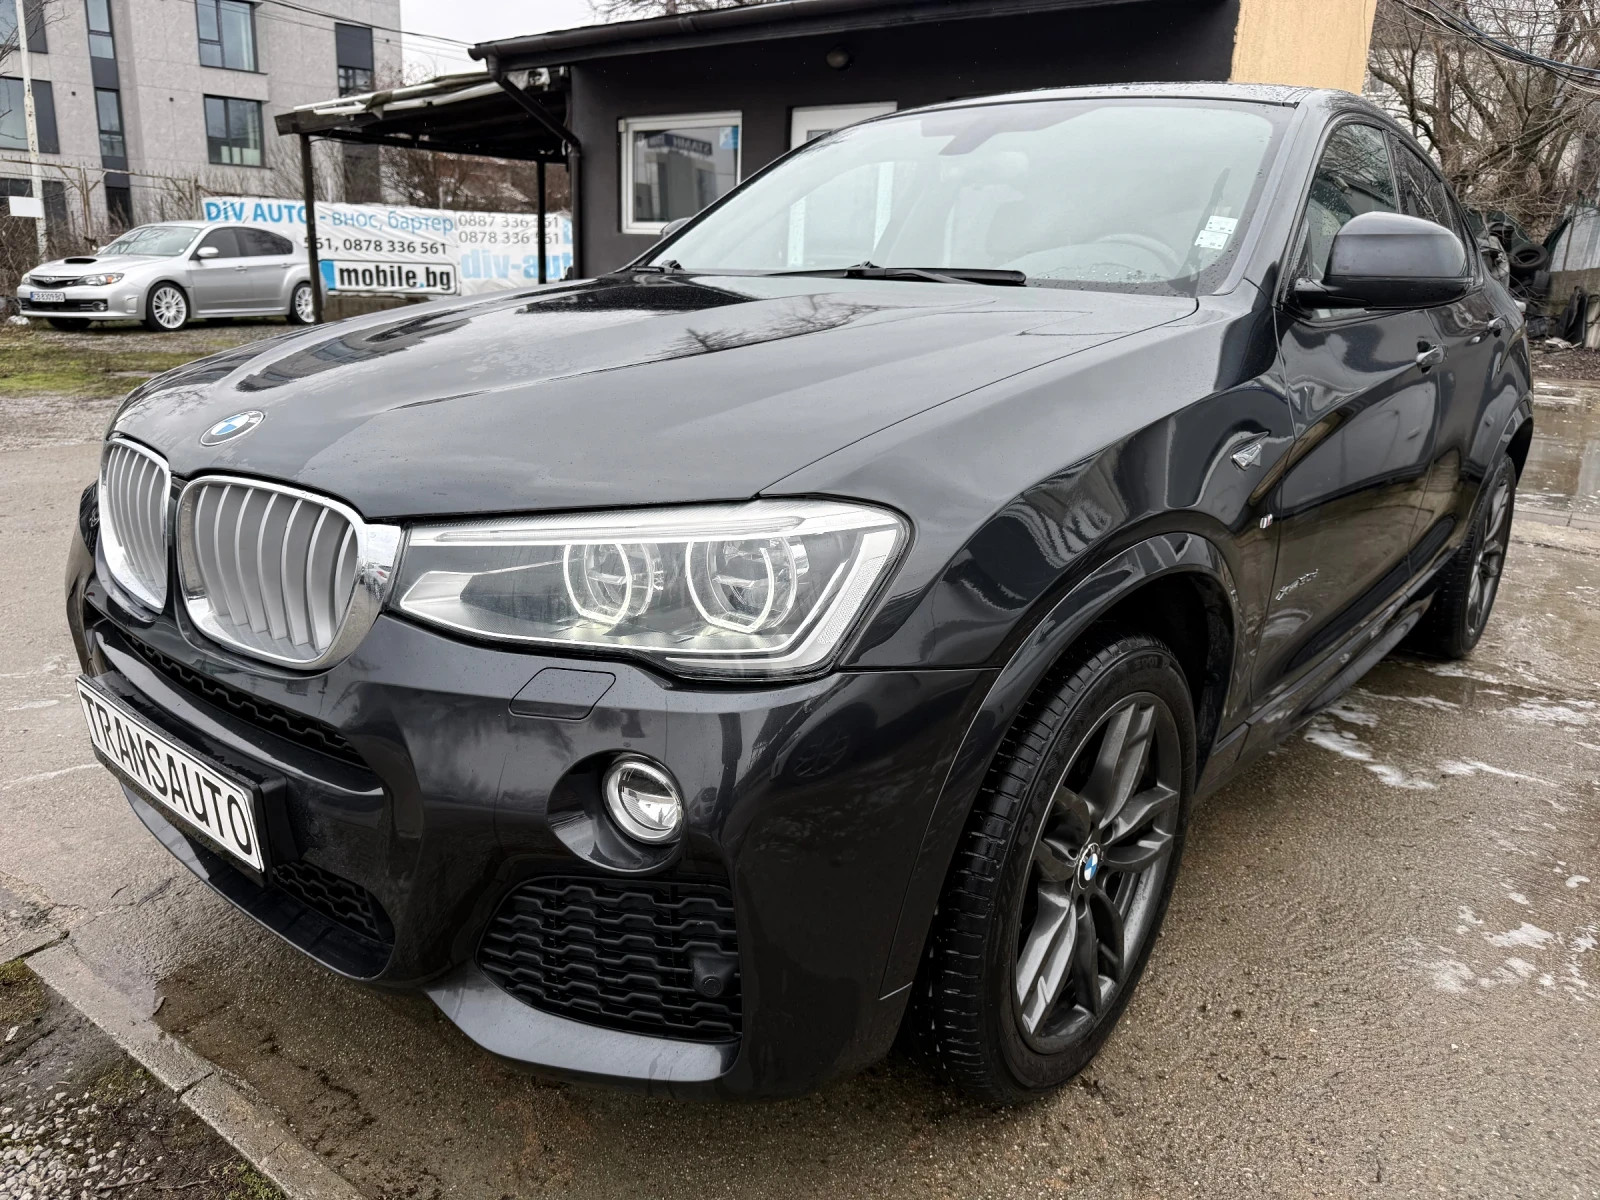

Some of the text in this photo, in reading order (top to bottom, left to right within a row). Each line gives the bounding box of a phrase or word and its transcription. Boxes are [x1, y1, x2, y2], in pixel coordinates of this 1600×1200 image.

[205, 201, 244, 222] DiV
[332, 211, 383, 231] внос,
[387, 211, 454, 236] бартер
[458, 214, 495, 227] 0887
[501, 216, 529, 228] 336
[343, 238, 383, 252] 0878
[387, 240, 416, 253] 336
[420, 242, 446, 255] 561
[459, 231, 497, 243] 0878
[502, 232, 530, 244] 336
[339, 265, 451, 290] mobile.bg
[80, 690, 253, 856] TRANSAUTO
